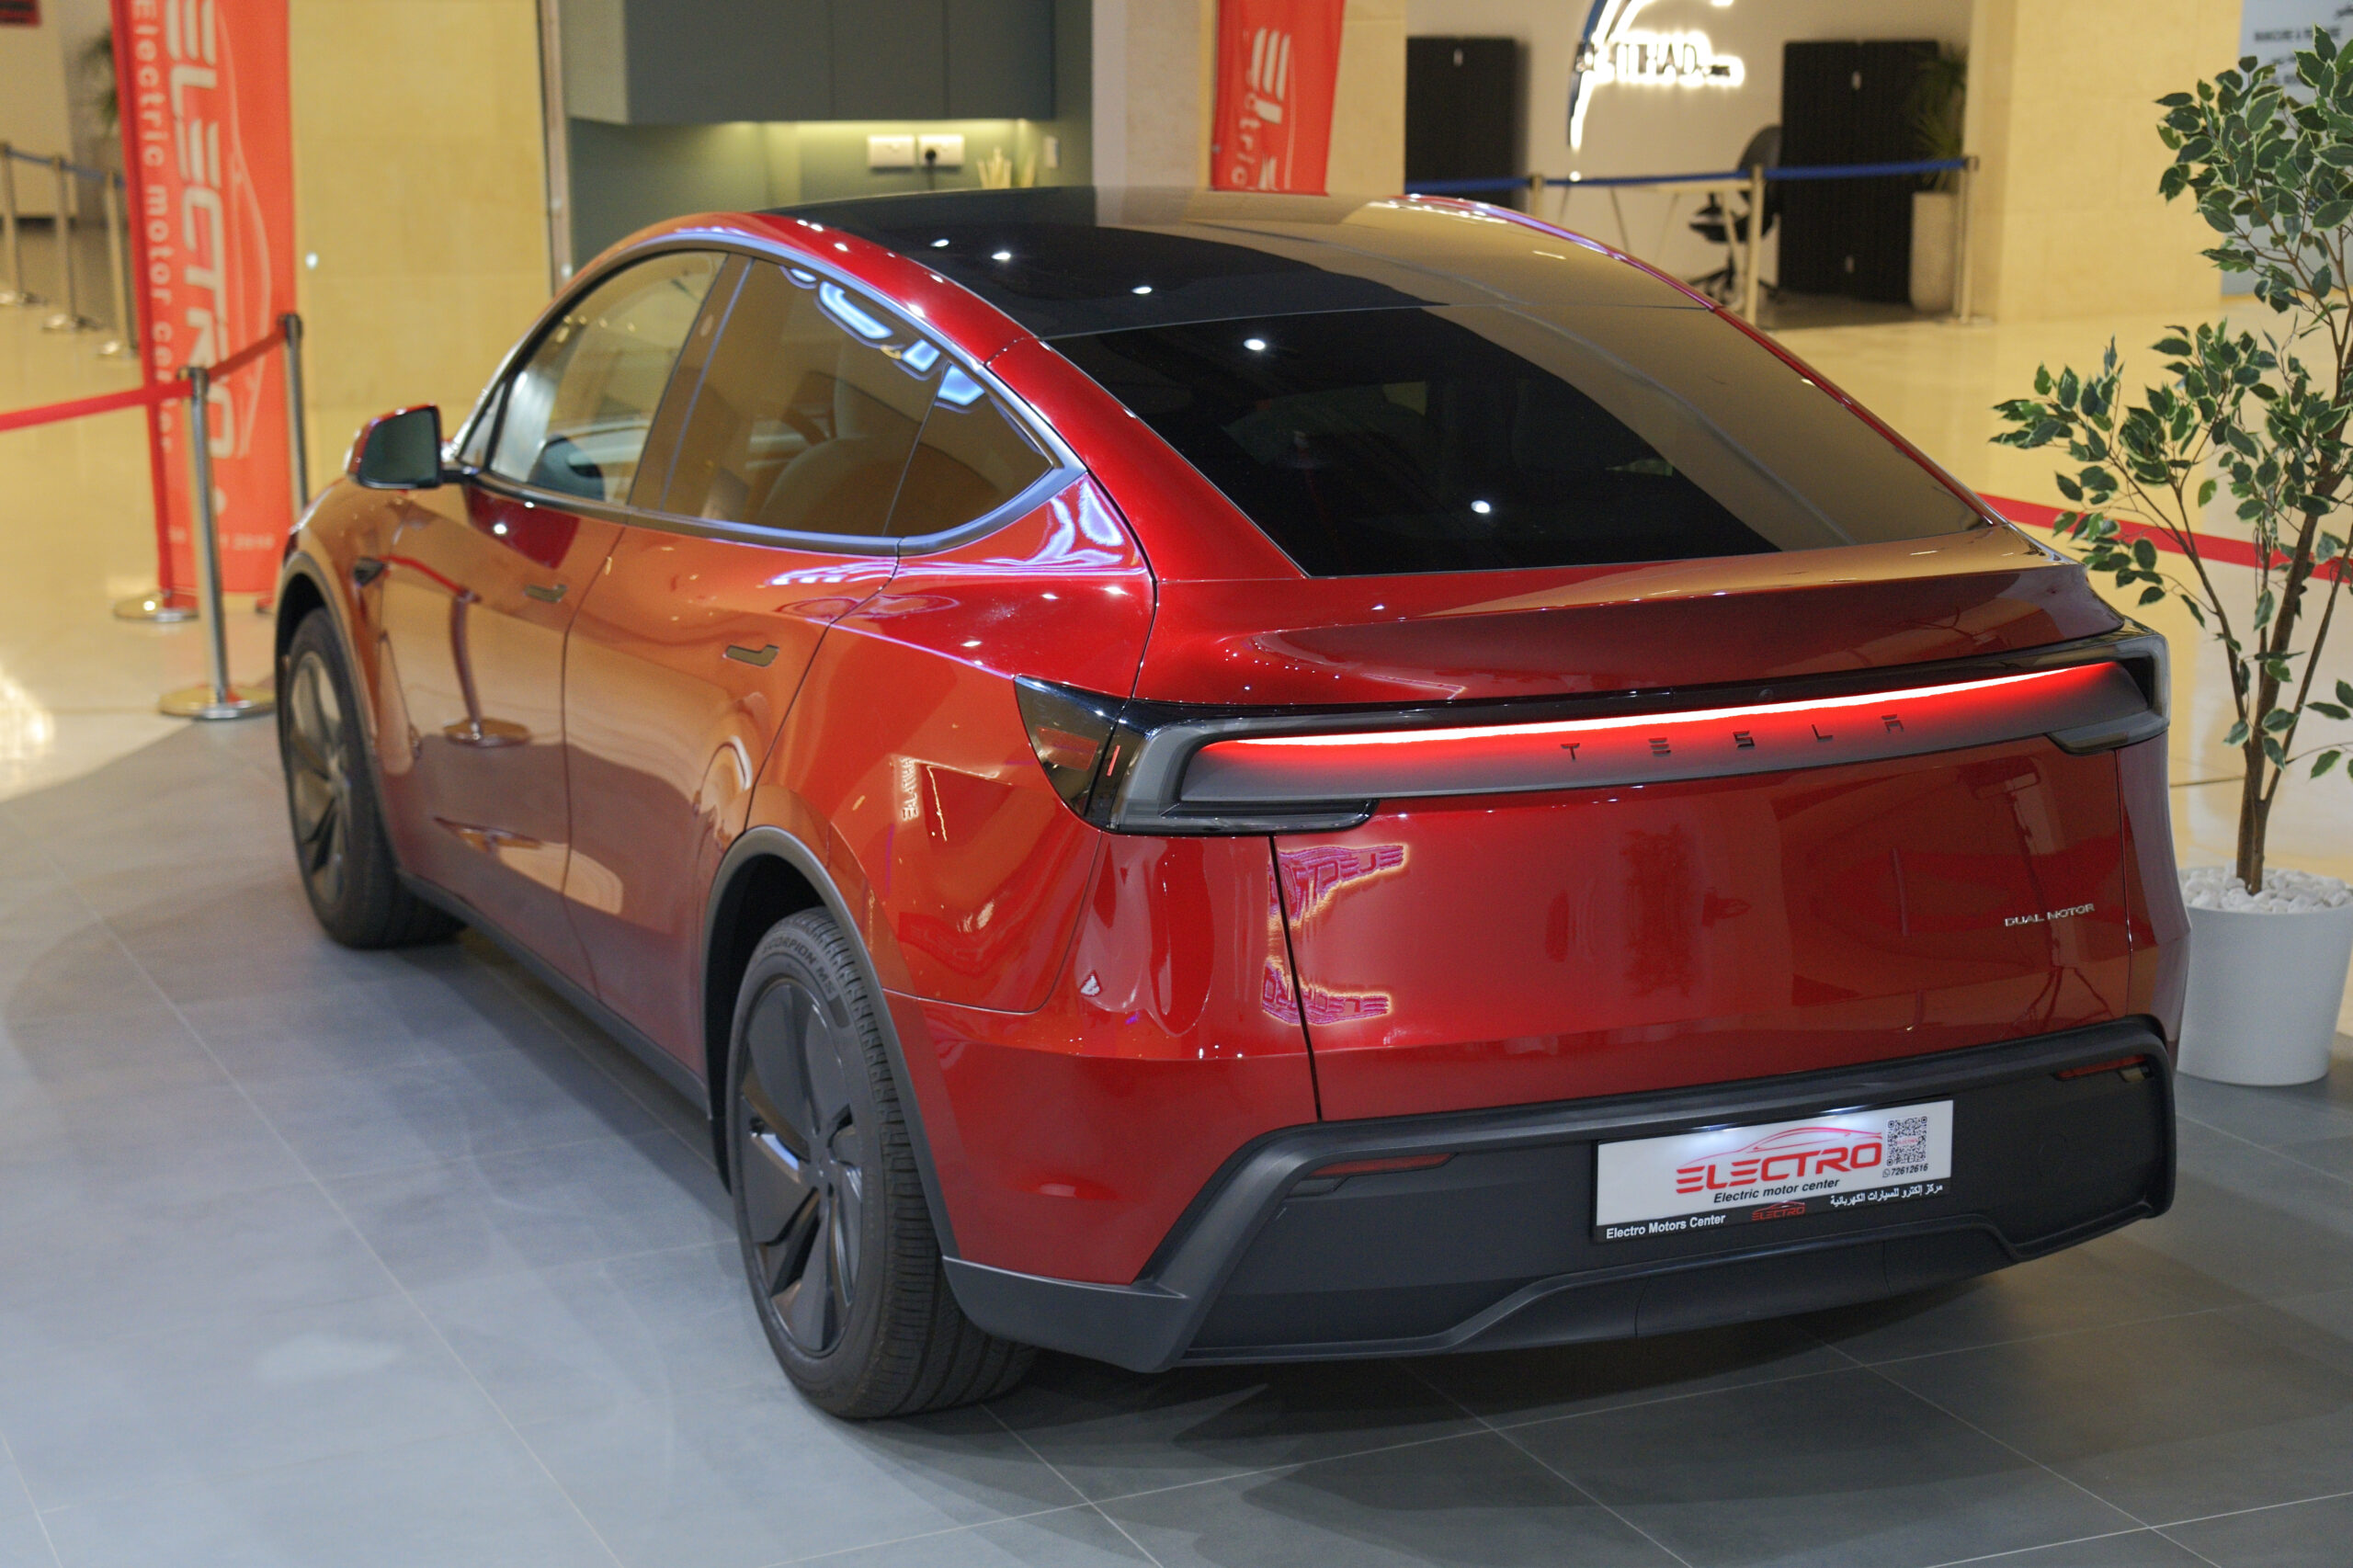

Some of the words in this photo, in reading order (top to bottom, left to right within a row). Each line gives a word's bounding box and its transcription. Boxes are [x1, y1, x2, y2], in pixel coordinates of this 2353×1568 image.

[147, 185, 175, 305] motor
[1561, 713, 1904, 761] TESLA
[2005, 914, 2045, 927] DUAL
[2047, 903, 2096, 920] MOTOR
[1676, 1142, 1882, 1195] ELECTRO
[1891, 1163, 1928, 1176] 72612616
[1713, 1187, 1759, 1204] Electric
[1762, 1184, 1800, 1199] motor
[1802, 1179, 1840, 1193] center
[1830, 1192, 1866, 1208] الكهربائية
[1867, 1187, 1900, 1201] للسيارات
[1925, 1183, 1943, 1195] مركز
[1751, 1205, 1806, 1221] ELECTRO
[1606, 1224, 1646, 1240] Electro
[1648, 1220, 1687, 1235] Motors
[1689, 1213, 1726, 1228] Center
